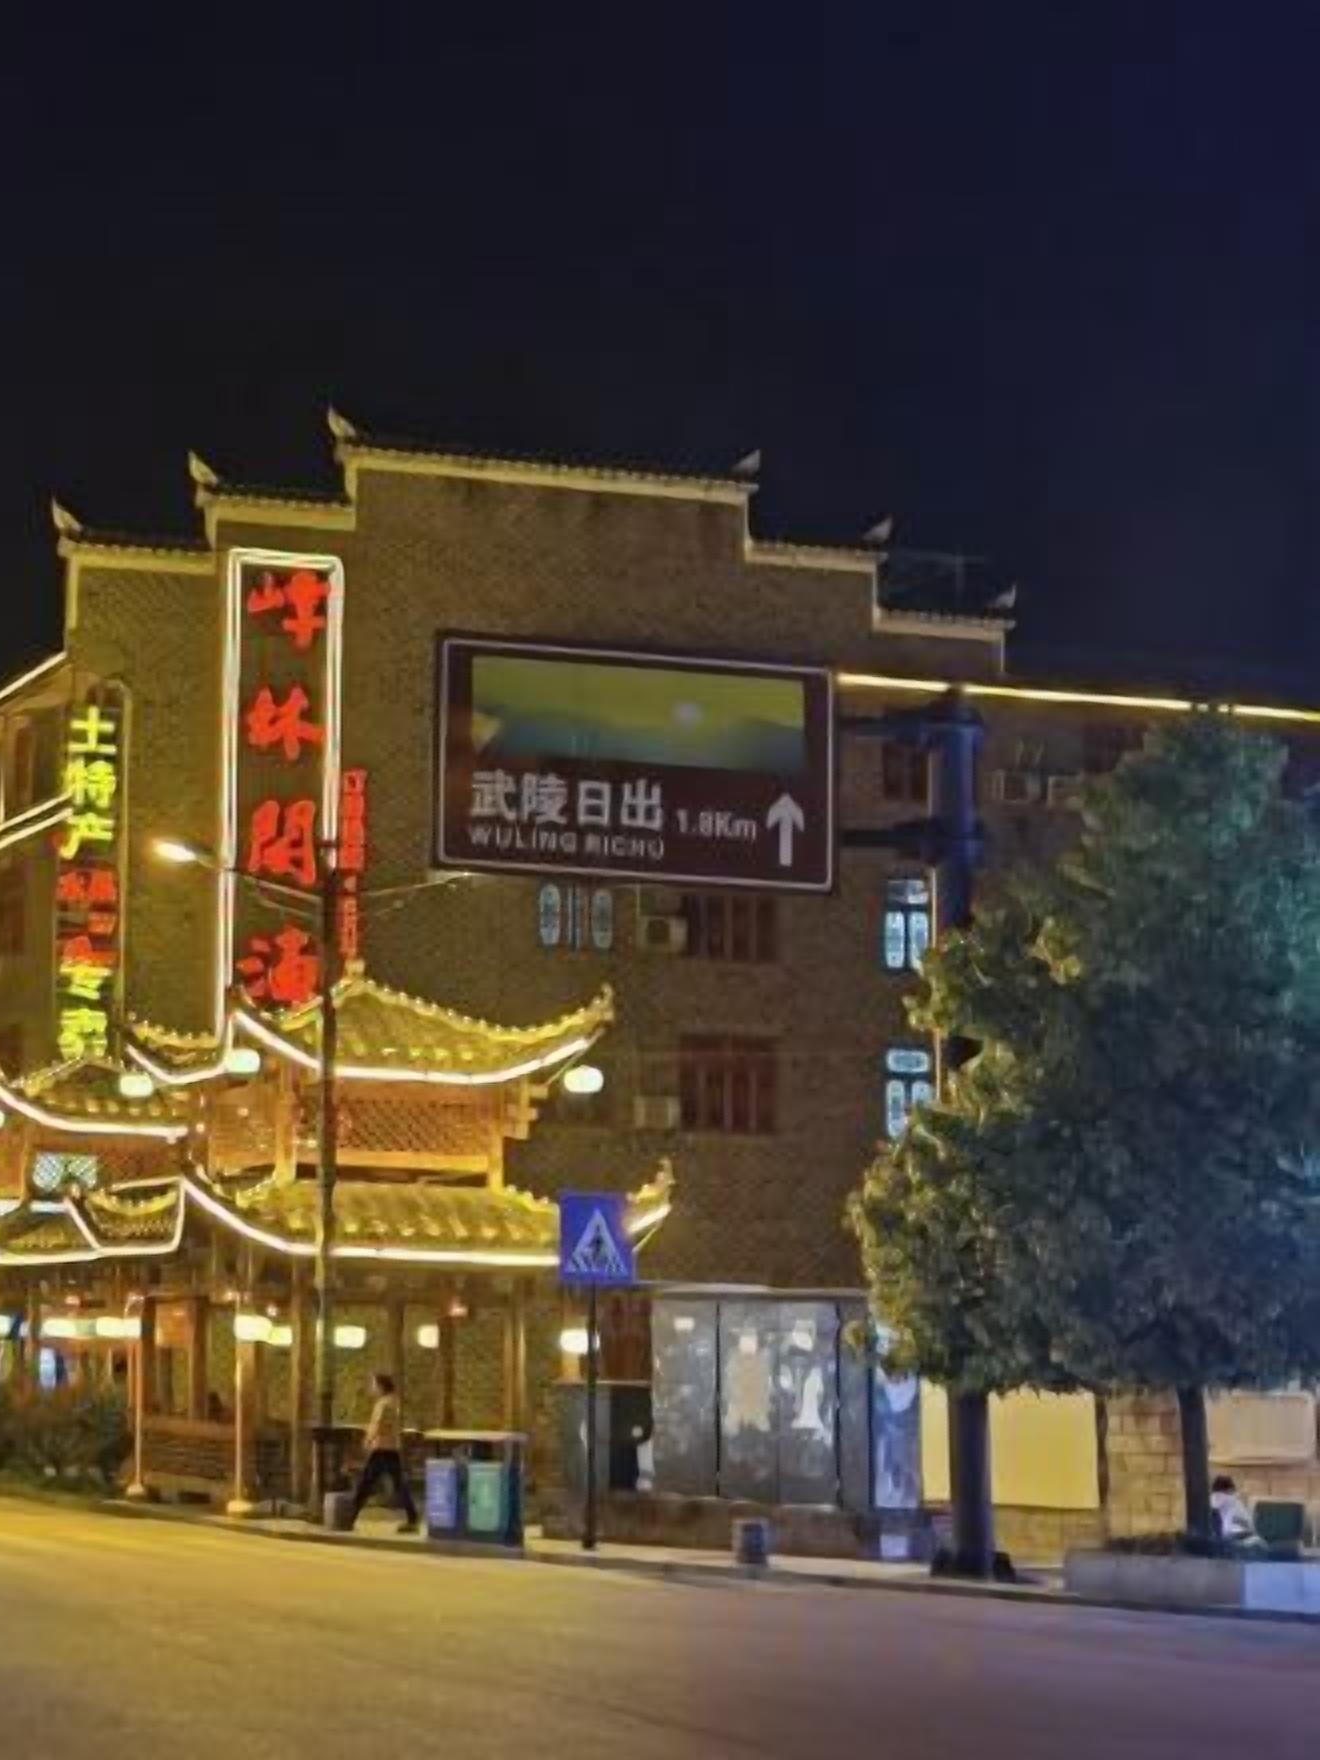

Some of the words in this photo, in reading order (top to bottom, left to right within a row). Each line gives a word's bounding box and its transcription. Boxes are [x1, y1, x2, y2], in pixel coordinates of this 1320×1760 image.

[472, 769, 663, 832] 武陵日出
[470, 824, 578, 853] WULING
